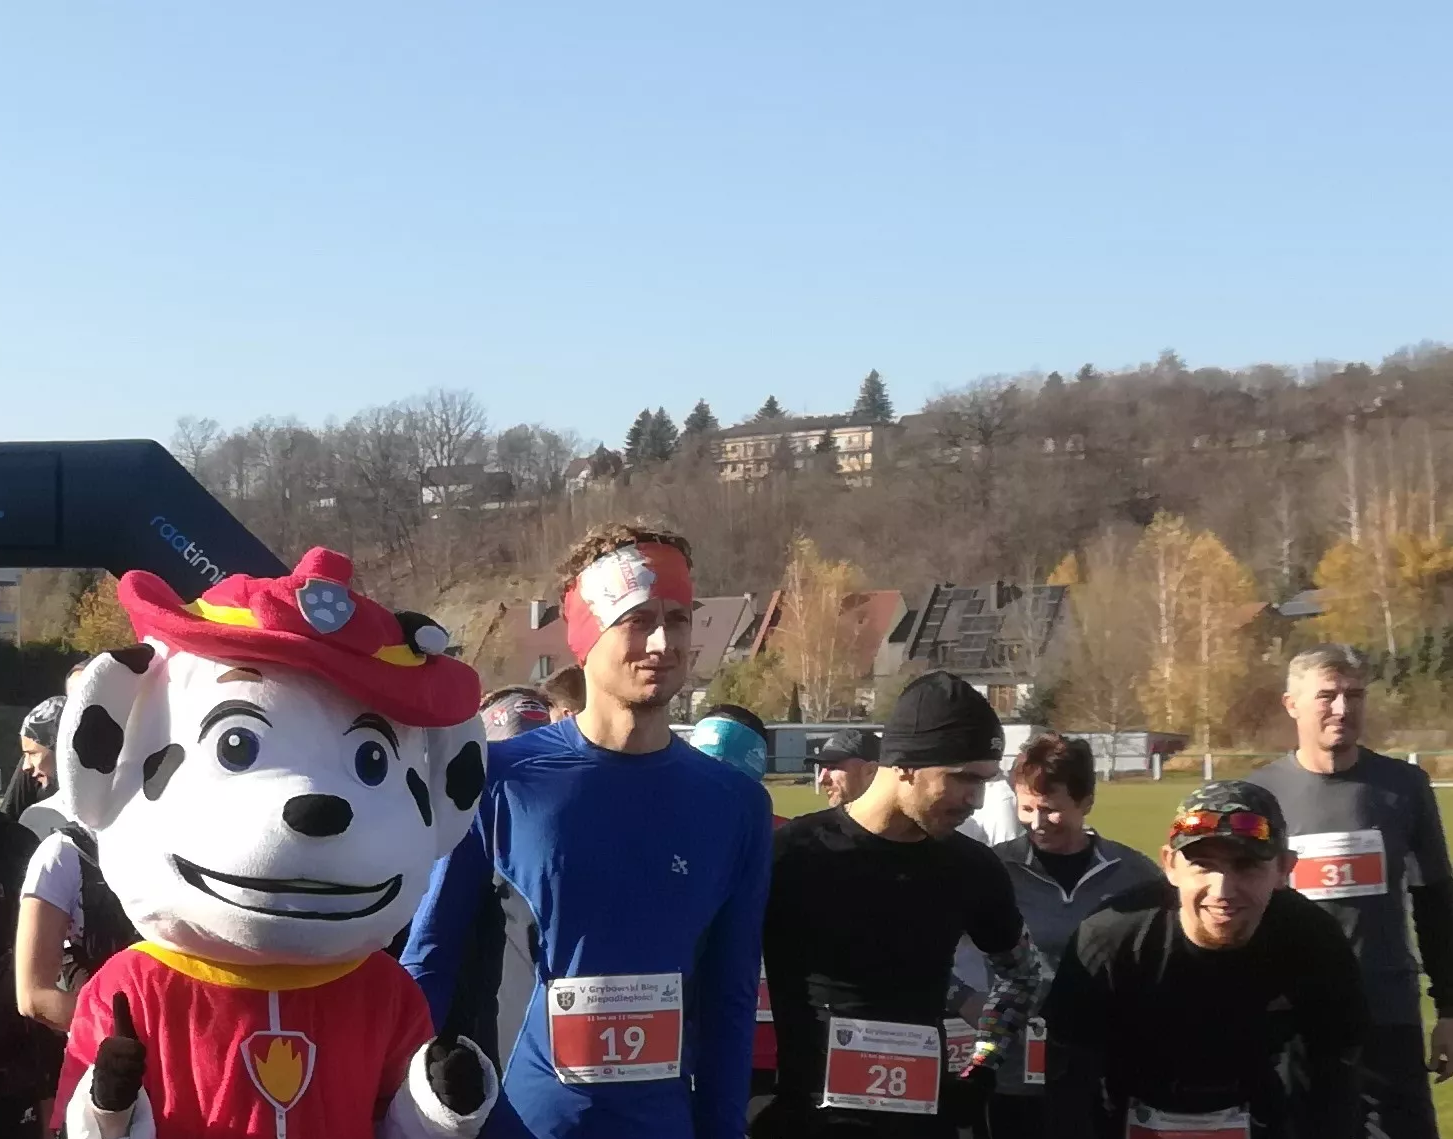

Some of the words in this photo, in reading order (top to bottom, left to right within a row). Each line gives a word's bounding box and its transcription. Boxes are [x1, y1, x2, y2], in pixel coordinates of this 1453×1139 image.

[150, 516, 227, 585] raatimi
[1320, 863, 1357, 887] 31
[599, 1026, 646, 1062] 19
[947, 1042, 973, 1065] 25
[866, 1065, 907, 1096] 28
